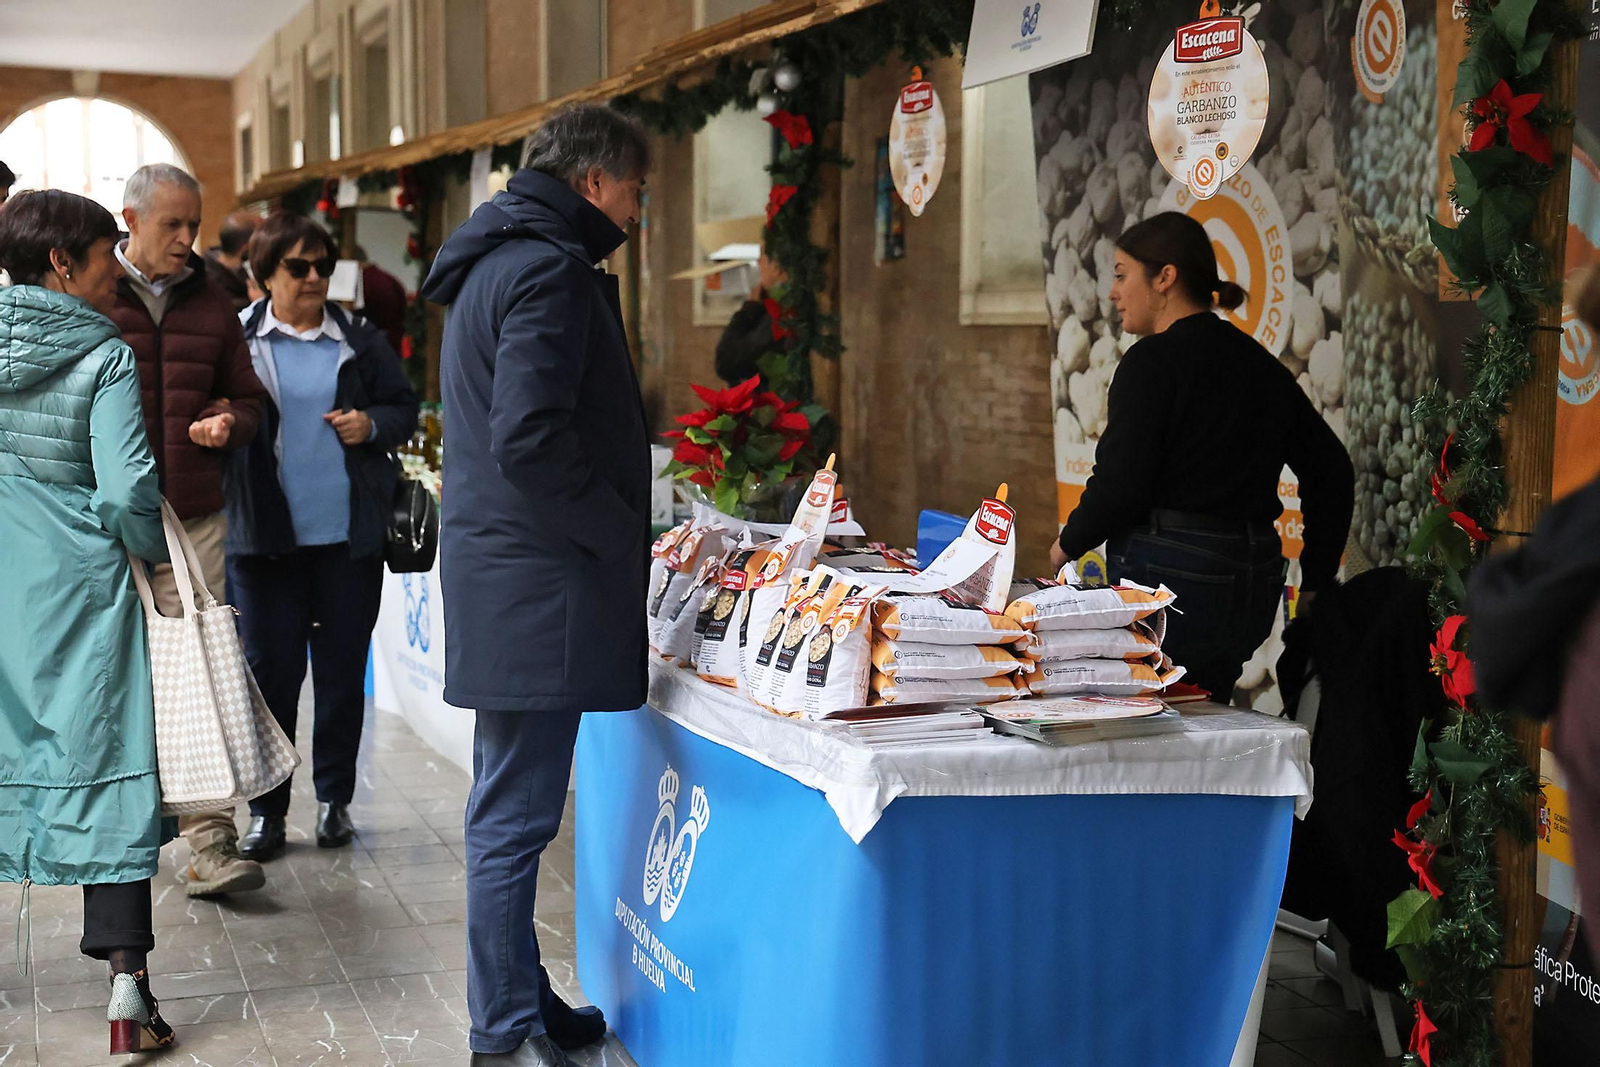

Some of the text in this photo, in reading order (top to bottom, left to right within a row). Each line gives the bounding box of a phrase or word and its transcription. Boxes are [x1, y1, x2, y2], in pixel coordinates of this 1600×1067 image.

[1181, 28, 1235, 49] Escacena
[1177, 95, 1237, 114] GARBANZO
[1177, 110, 1236, 125] BLANCO LECHOSO
[1261, 223, 1288, 349] ESCACE
[981, 505, 1010, 532] Escacena
[614, 896, 696, 993] DIPUTACIÓN PROVINCIAL
[638, 949, 666, 993] HUELVA
